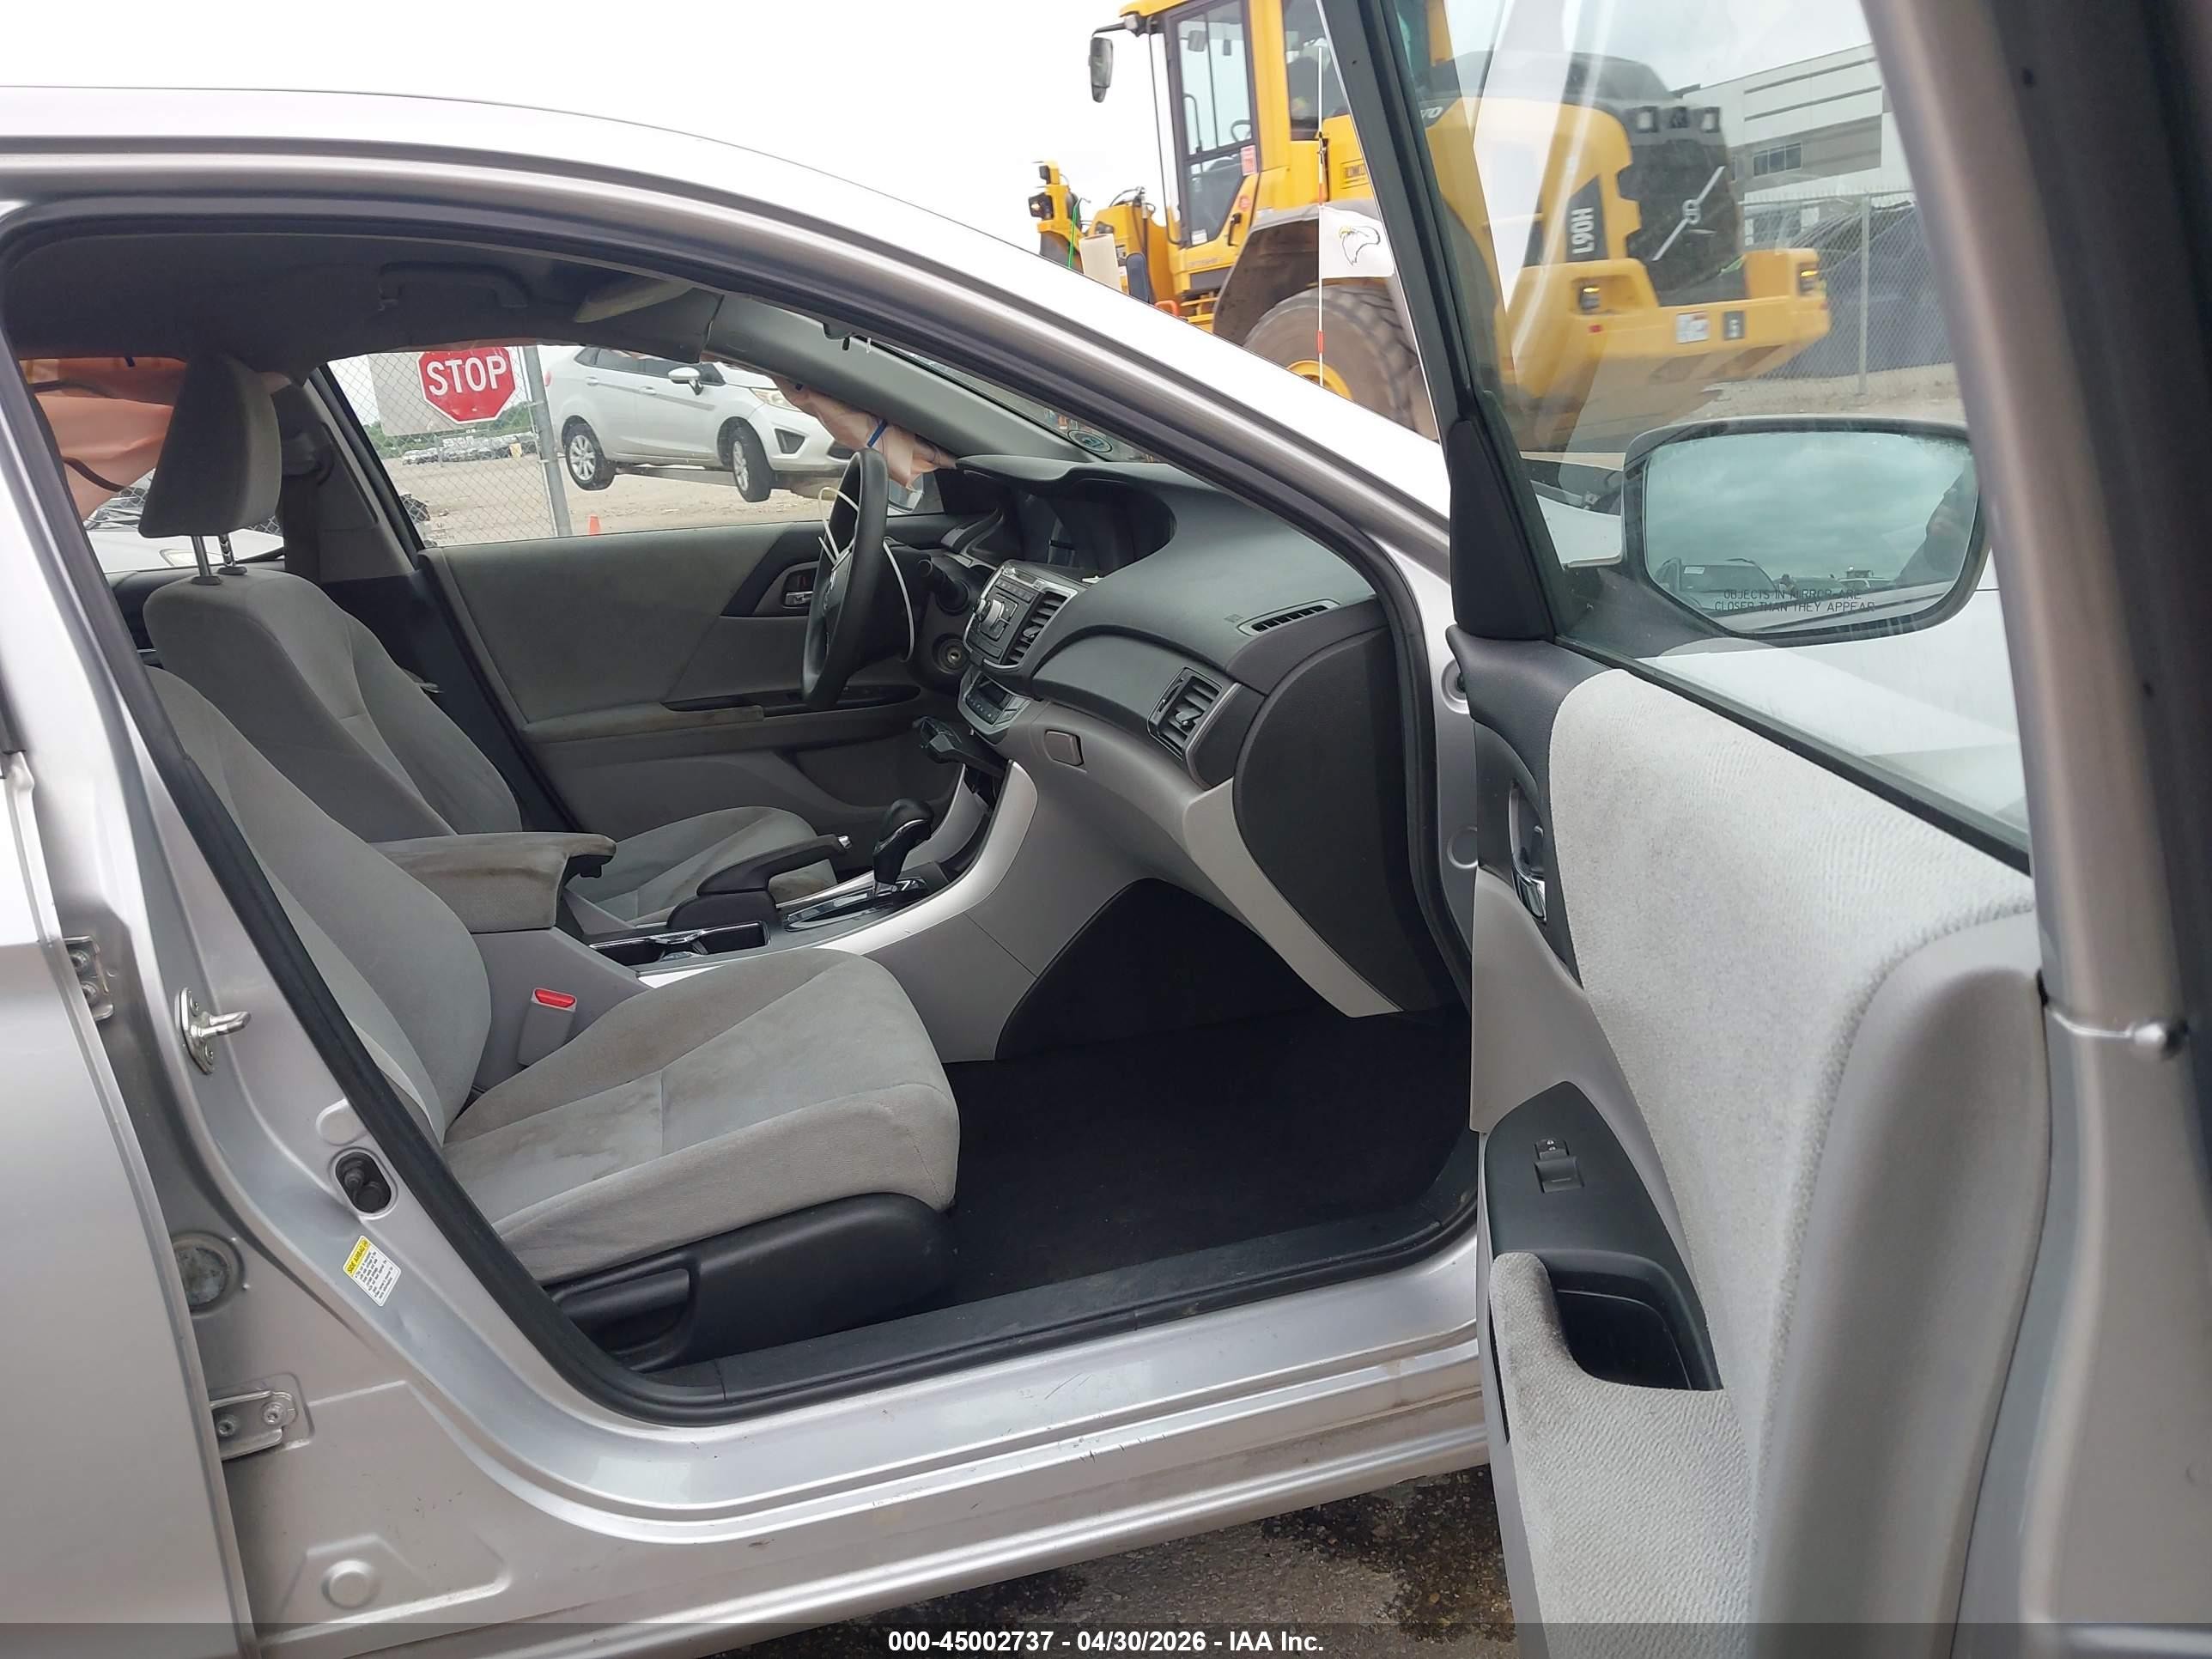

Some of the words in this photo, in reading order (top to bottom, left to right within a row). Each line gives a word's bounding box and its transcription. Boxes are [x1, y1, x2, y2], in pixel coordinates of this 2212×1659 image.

[1571, 207, 1595, 255] L90H
[426, 355, 507, 396] STOP
[1714, 602, 1755, 612] CLOSER
[1763, 601, 1789, 612] THAN
[1792, 601, 1821, 612] THEY
[1826, 601, 1875, 612] APPEAR
[1723, 589, 1770, 599] OBJECTS
[1775, 589, 1785, 599] IN
[1790, 589, 1832, 599] MIRROR
[1839, 589, 1862, 599] ARE
